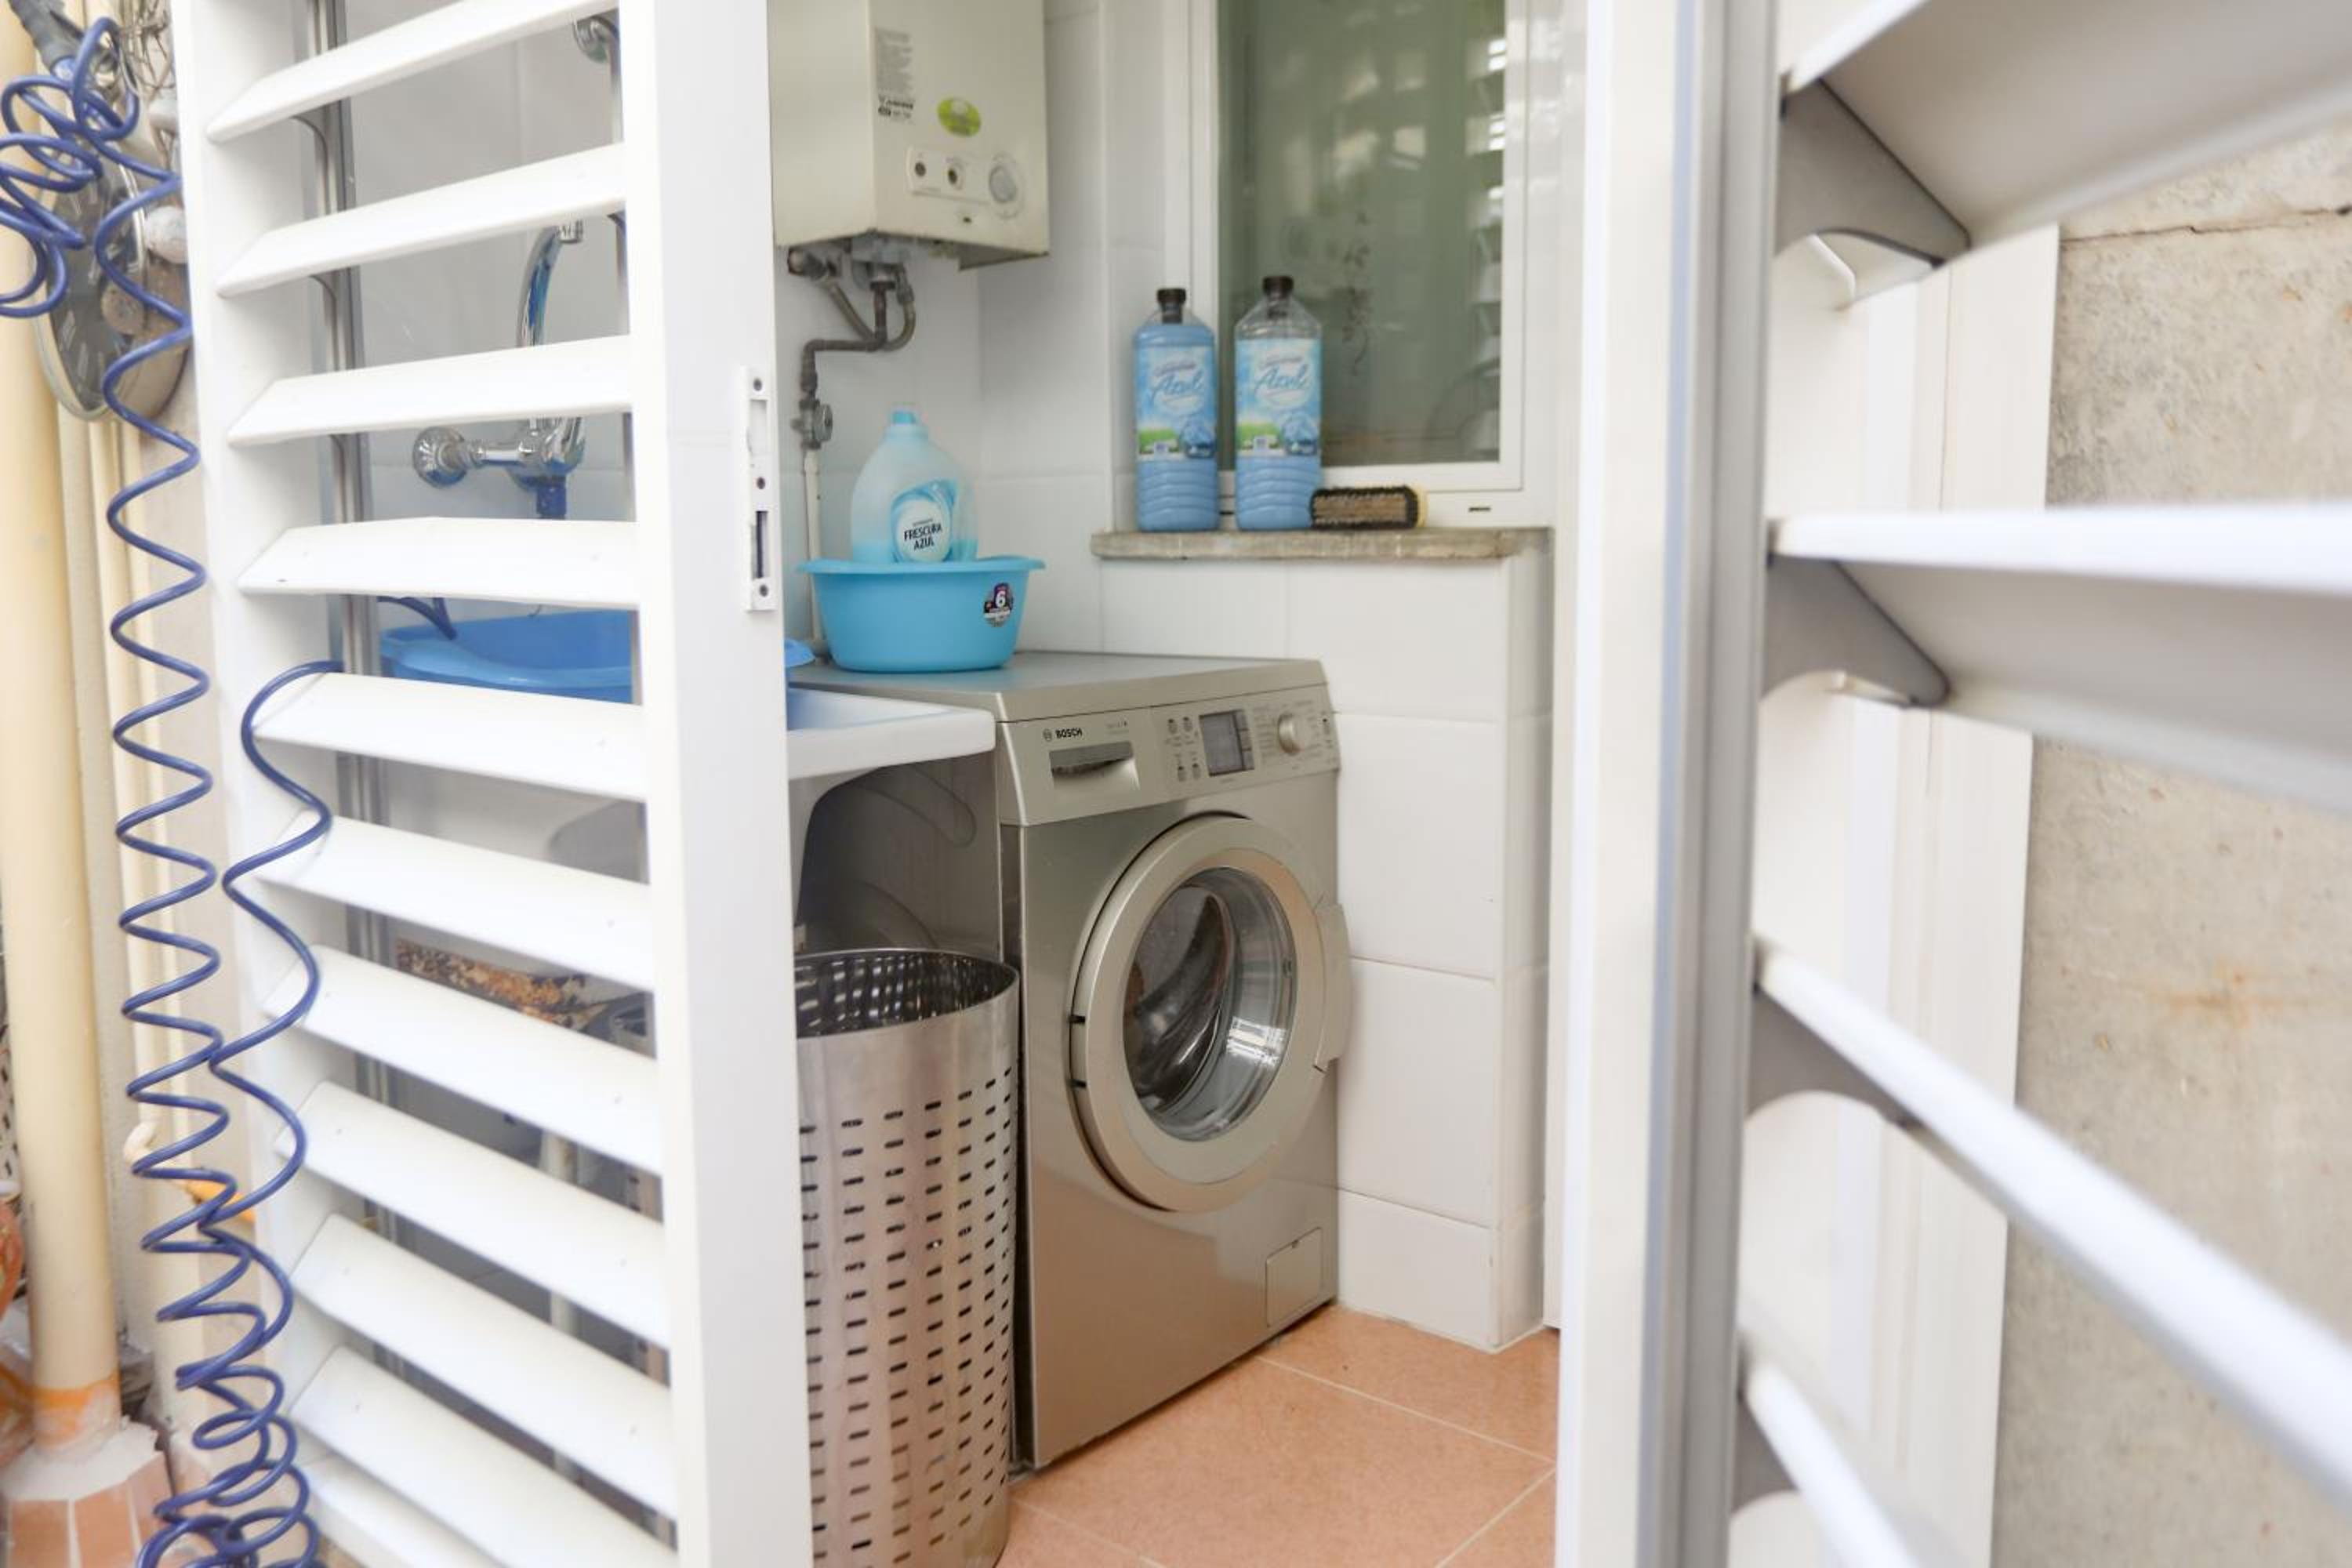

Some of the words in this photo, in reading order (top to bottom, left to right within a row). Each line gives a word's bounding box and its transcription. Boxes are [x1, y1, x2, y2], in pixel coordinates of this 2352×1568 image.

[904, 523, 942, 541] FRESCURA
[913, 536, 935, 550] AZUL
[1054, 728, 1083, 739] BOSCH
